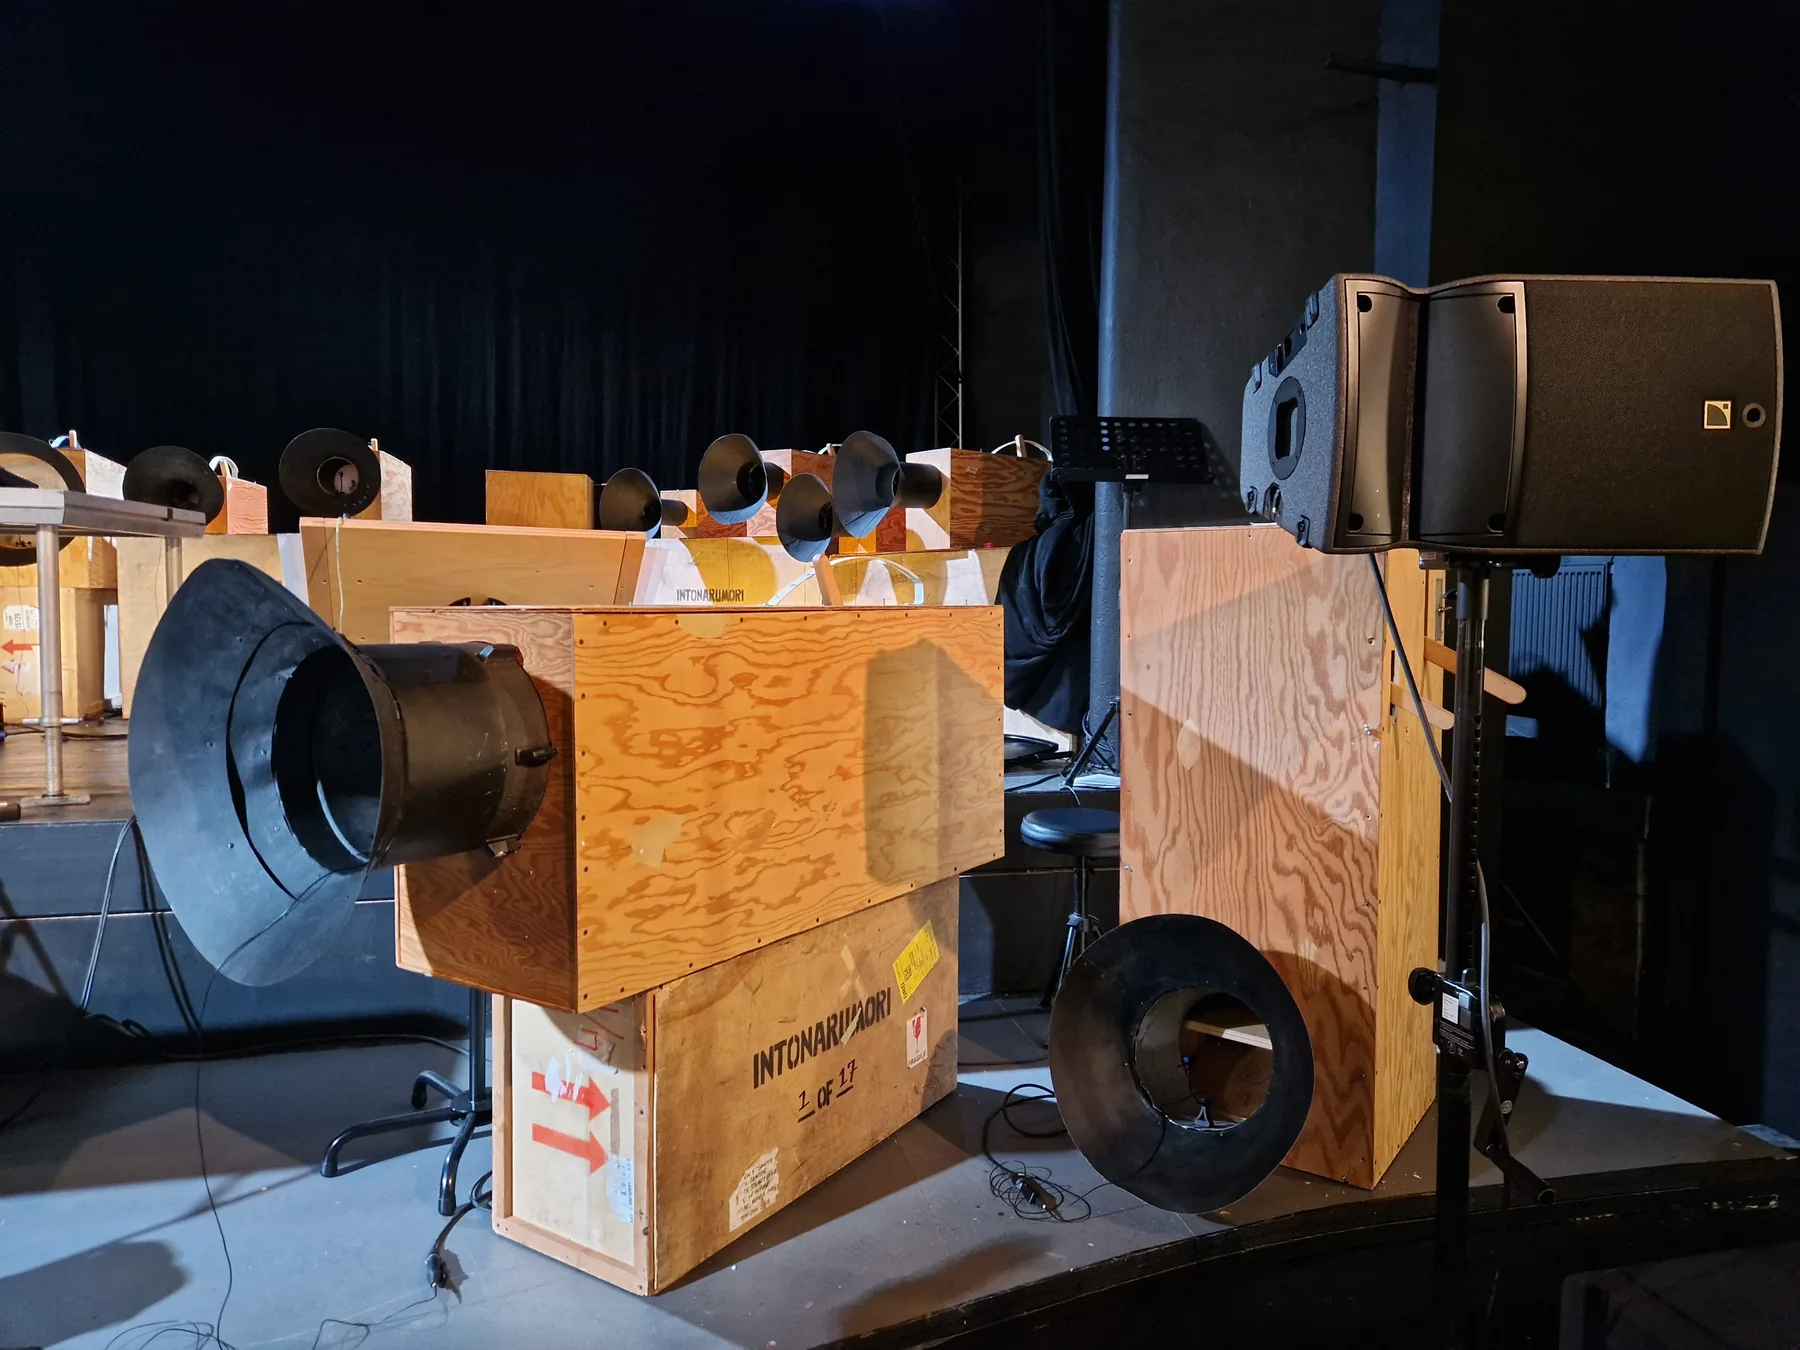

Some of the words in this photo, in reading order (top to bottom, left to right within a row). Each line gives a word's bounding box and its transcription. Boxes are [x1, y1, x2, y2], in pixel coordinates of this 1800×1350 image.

[676, 588, 744, 602] INTONARUMORI
[753, 987, 891, 1089] INTONARUMORI
[908, 1051, 926, 1067] FRAGILE
[817, 1079, 834, 1109] OF
[838, 1059, 858, 1087] 17
